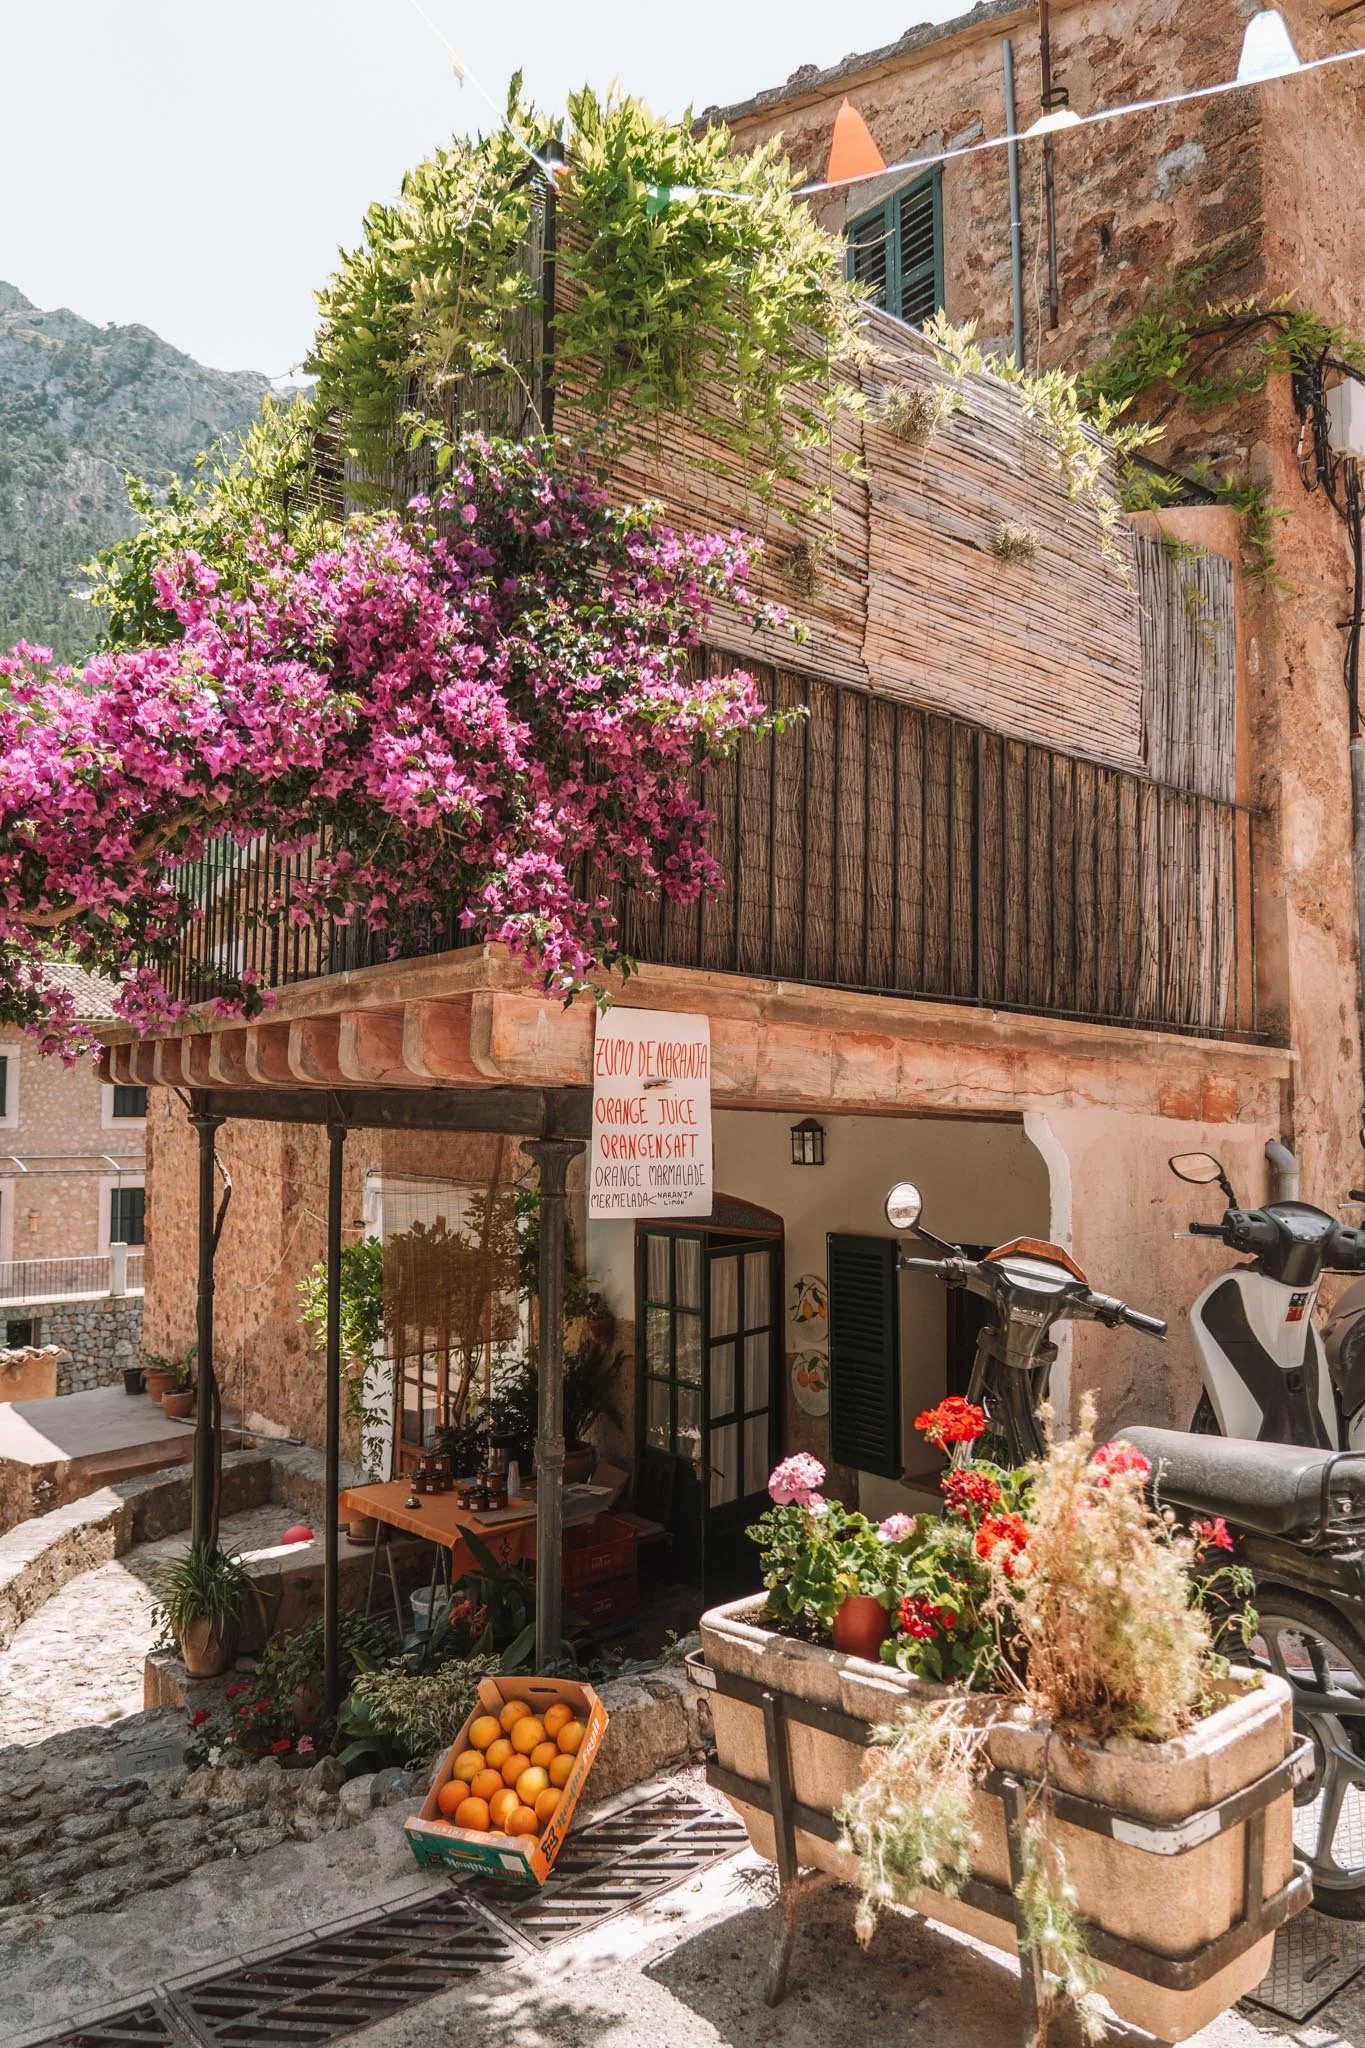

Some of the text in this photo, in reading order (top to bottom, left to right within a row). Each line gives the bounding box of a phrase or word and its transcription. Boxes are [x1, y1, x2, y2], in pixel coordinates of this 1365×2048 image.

[595, 1038, 708, 1079] ZUMO DE NARANJA
[595, 1097, 648, 1125] ORANGE
[600, 1133, 699, 1160] ORANGENSAFT
[595, 1163, 706, 1187] ORANGE MARMALADE
[591, 1191, 693, 1209] MERMELADA NARANJA
